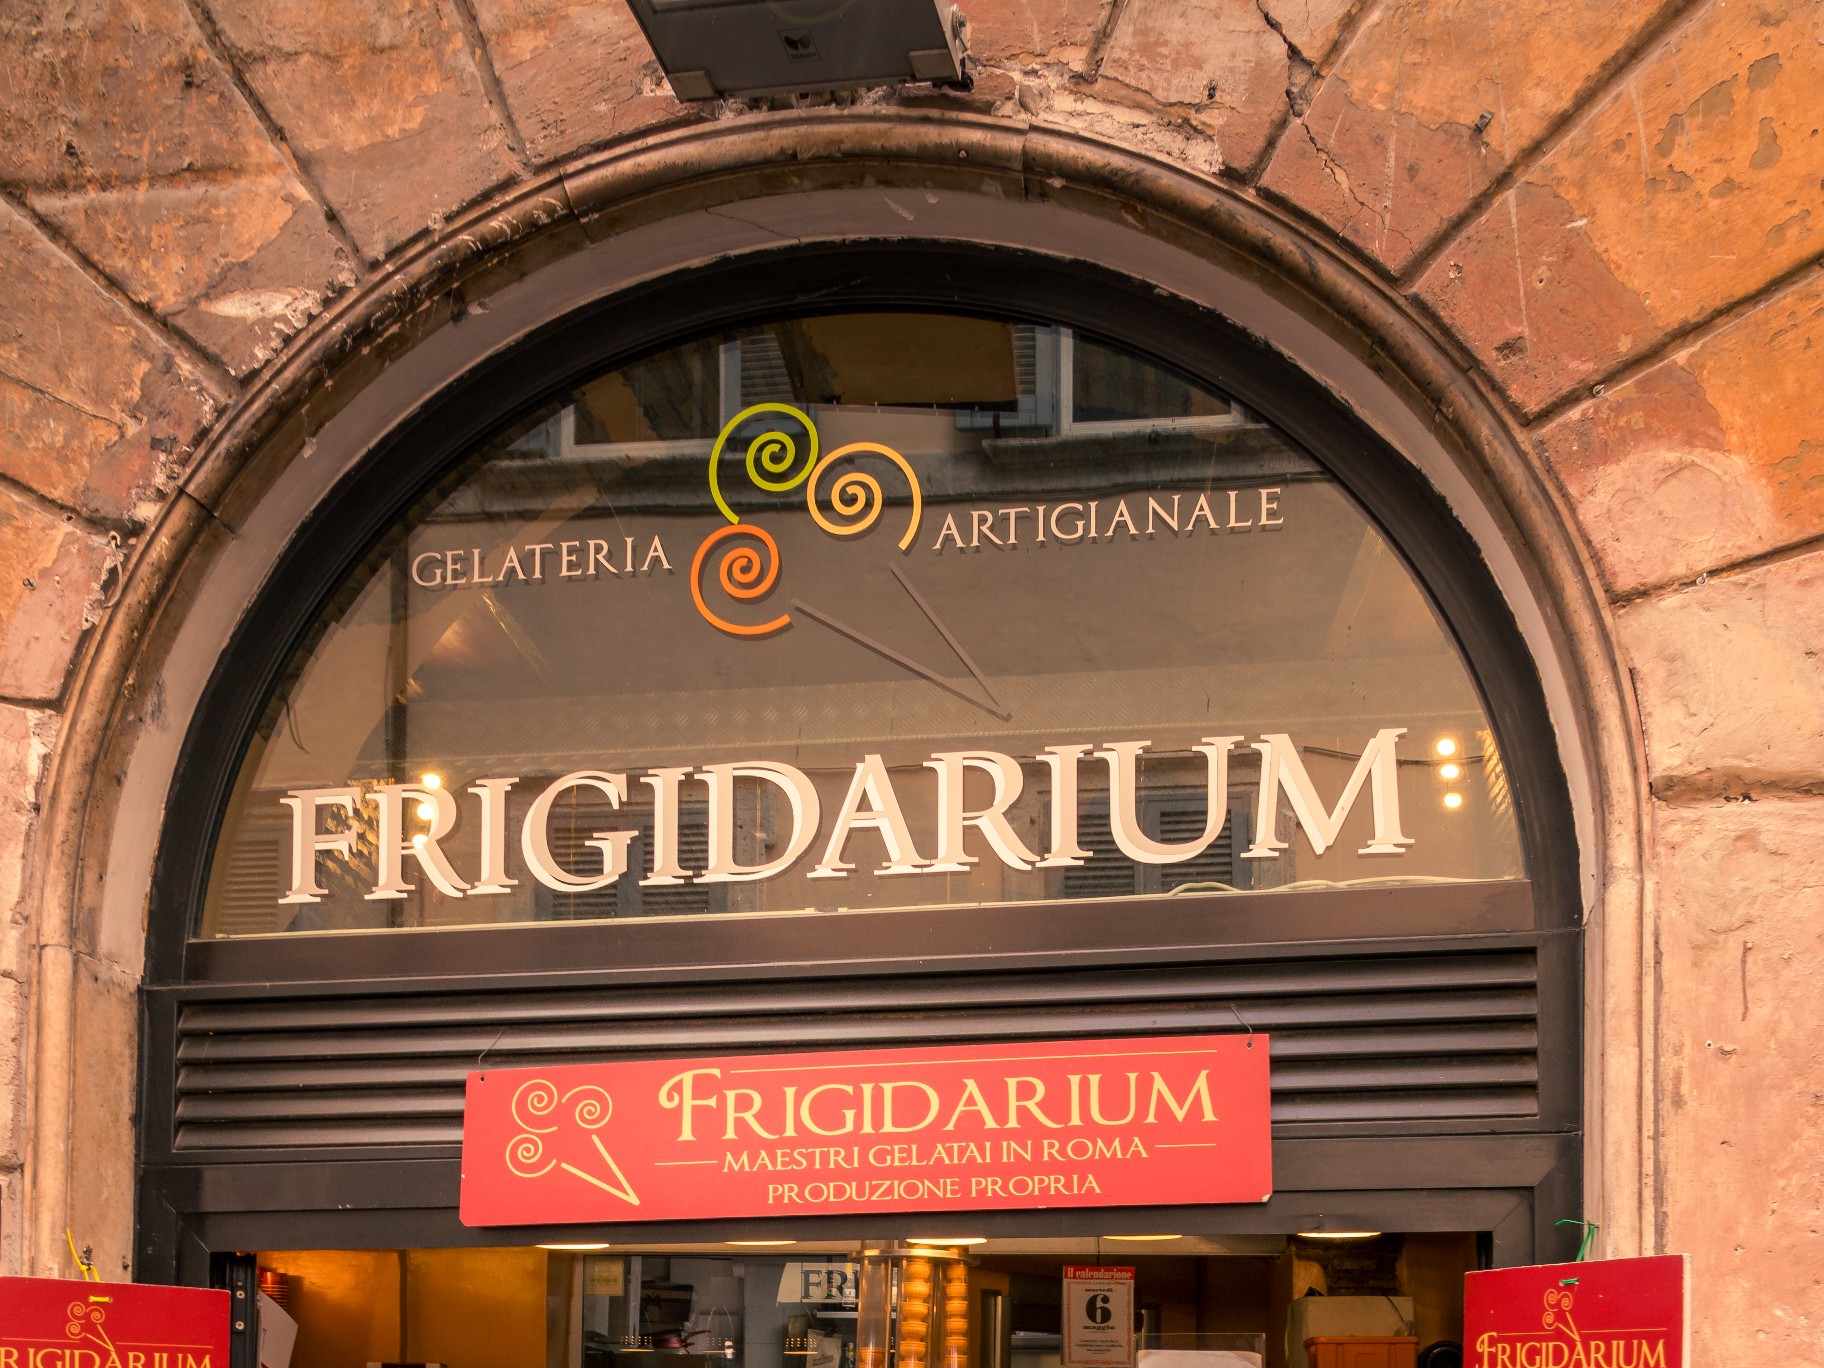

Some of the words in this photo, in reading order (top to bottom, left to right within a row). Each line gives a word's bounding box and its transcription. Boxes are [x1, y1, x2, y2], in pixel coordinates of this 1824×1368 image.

[933, 487, 1286, 551] ARTIGIANALE
[411, 534, 674, 588] GELATERIA
[278, 726, 1416, 905] FRIGIDARIUM
[658, 1067, 1220, 1142] FRIGIDARIUM
[723, 1145, 862, 1173] MAESTRI
[868, 1141, 993, 1169] GELATAI
[1001, 1138, 1035, 1164] IN
[1042, 1136, 1150, 1161] ROMA
[767, 1177, 960, 1204] PRODUZIONE
[971, 1173, 1103, 1199] PROPRIA
[1067, 1267, 1074, 1278] il
[1075, 1268, 1132, 1280] calendarione
[1086, 1293, 1112, 1325] 6
